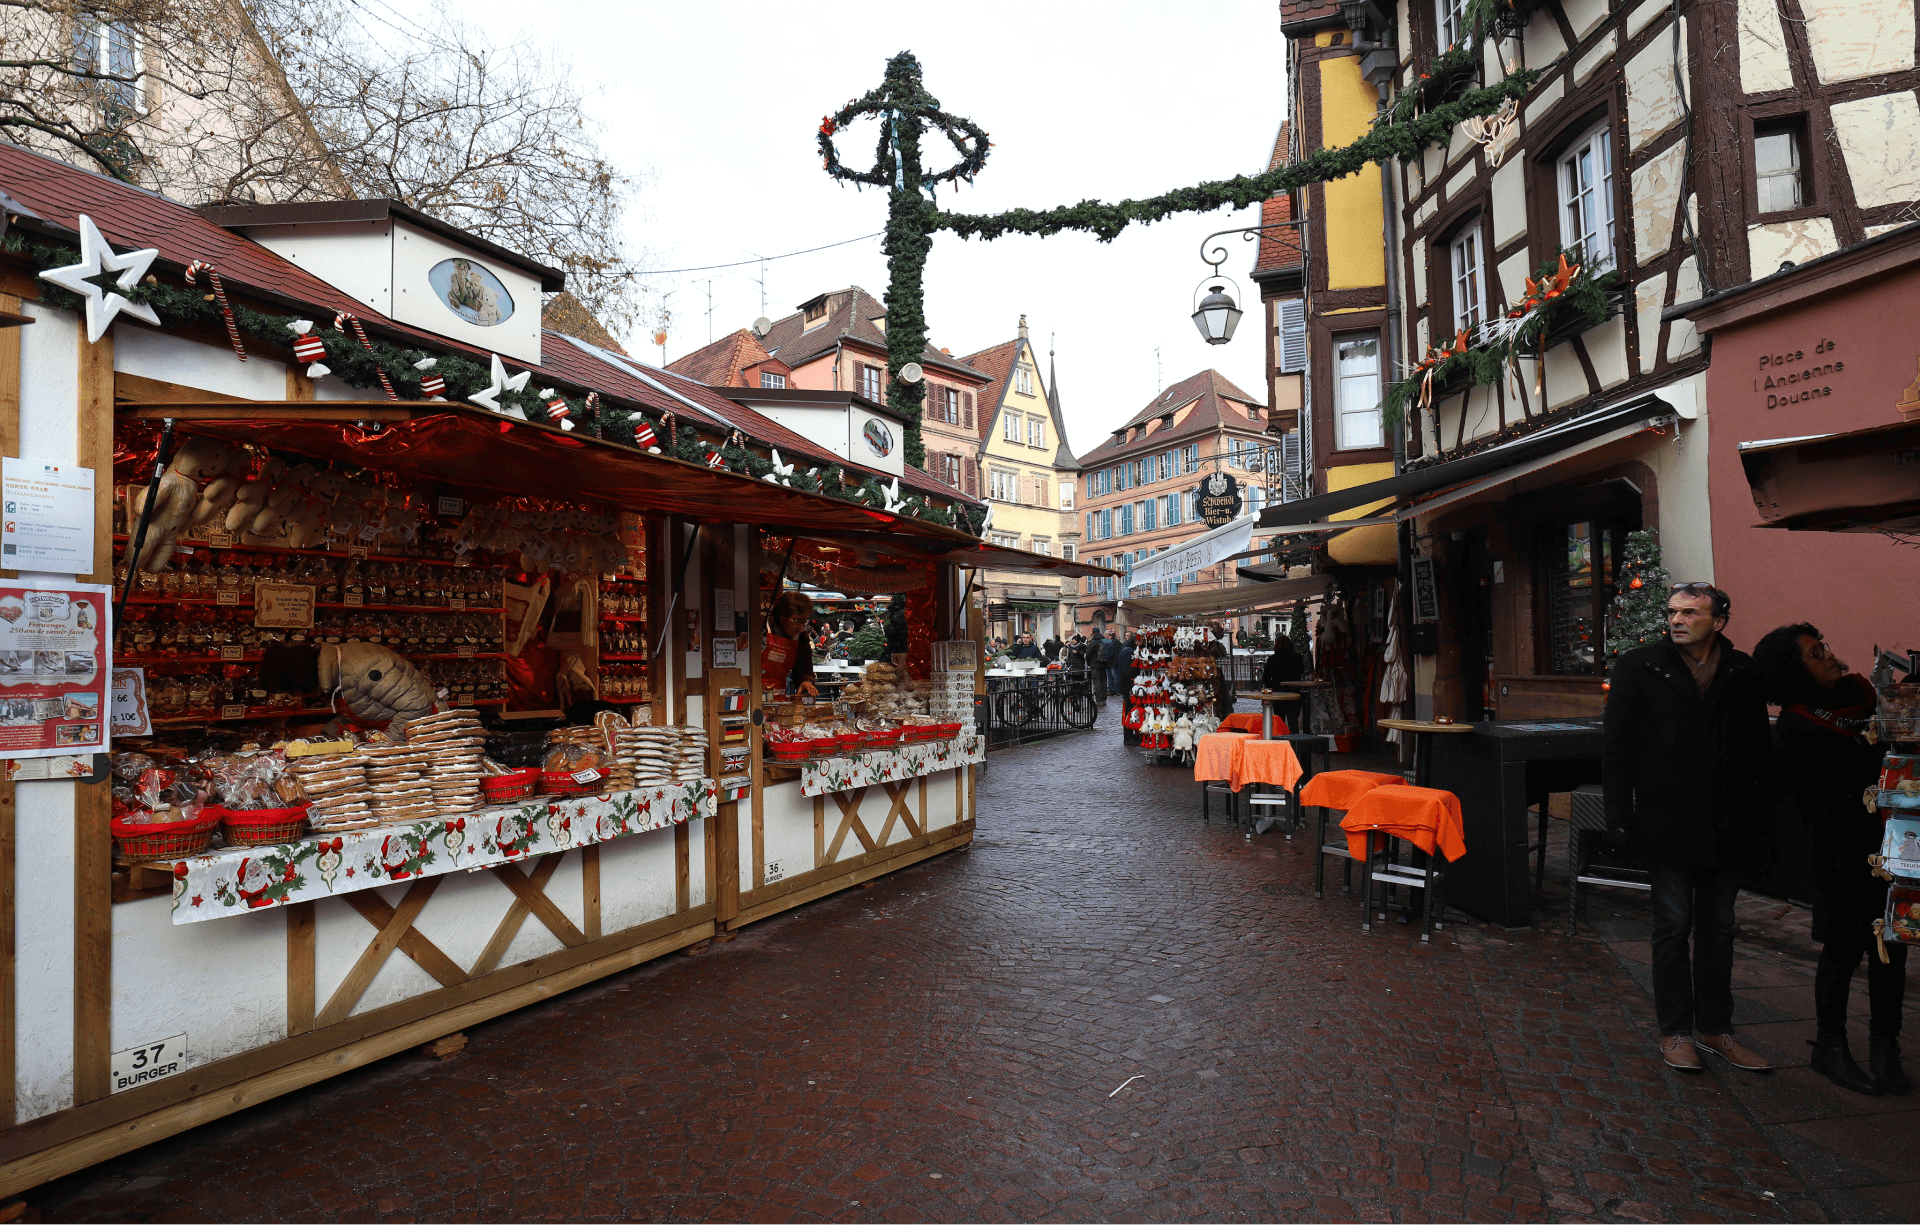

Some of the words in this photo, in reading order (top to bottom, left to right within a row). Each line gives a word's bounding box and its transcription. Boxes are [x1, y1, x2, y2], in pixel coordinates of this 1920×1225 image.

[1759, 350, 1804, 370] Place
[1816, 338, 1836, 354] de
[1767, 386, 1832, 409] Douane
[1202, 495, 1234, 507] Schwendi
[117, 694, 128, 702] 6€
[121, 713, 136, 721] 10€
[769, 863, 779, 874] 36
[132, 1044, 165, 1069] 37
[118, 1062, 178, 1088] BURGER
